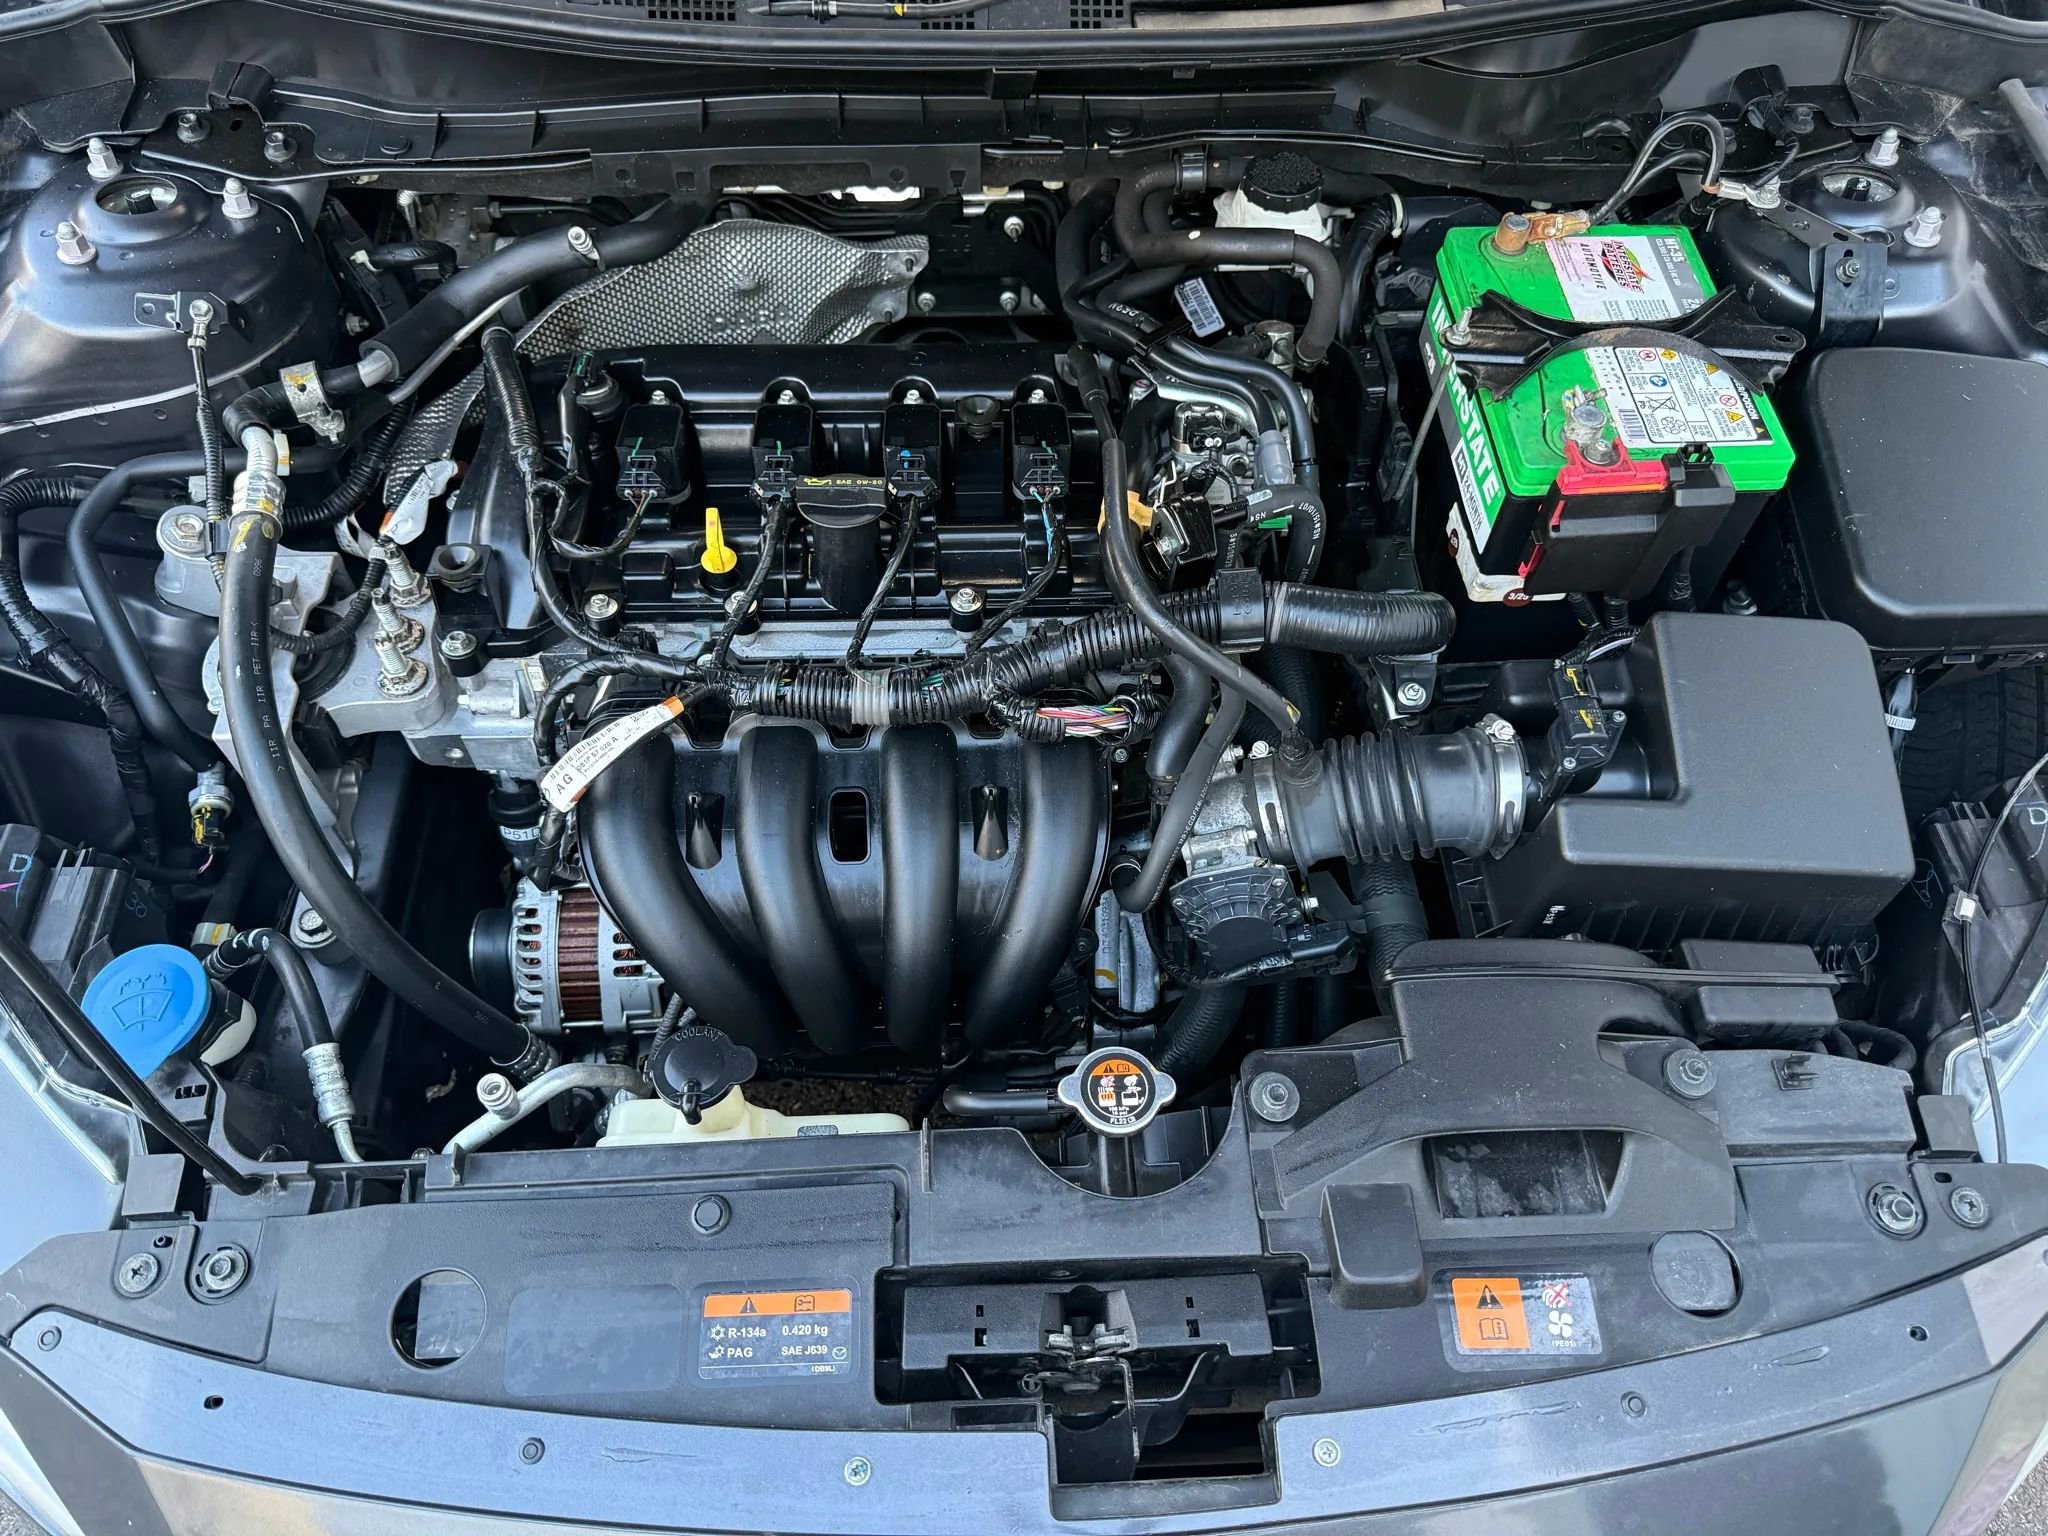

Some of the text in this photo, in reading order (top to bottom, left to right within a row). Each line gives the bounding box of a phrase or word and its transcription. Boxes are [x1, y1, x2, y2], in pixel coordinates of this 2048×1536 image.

[1664, 238, 1685, 263] MT-35
[1579, 242, 1606, 290] AUTOMOTIVE
[1603, 242, 1630, 288] BATTERIES
[1613, 240, 1640, 292] INTERSTATE
[1431, 297, 1501, 506] INERSTATE
[674, 1026, 723, 1042] COOLANT
[1109, 1117, 1127, 1125] FL22
[727, 1324, 828, 1339] R-134a 0.420 kg
[727, 1345, 828, 1358] PAG SAE J639
